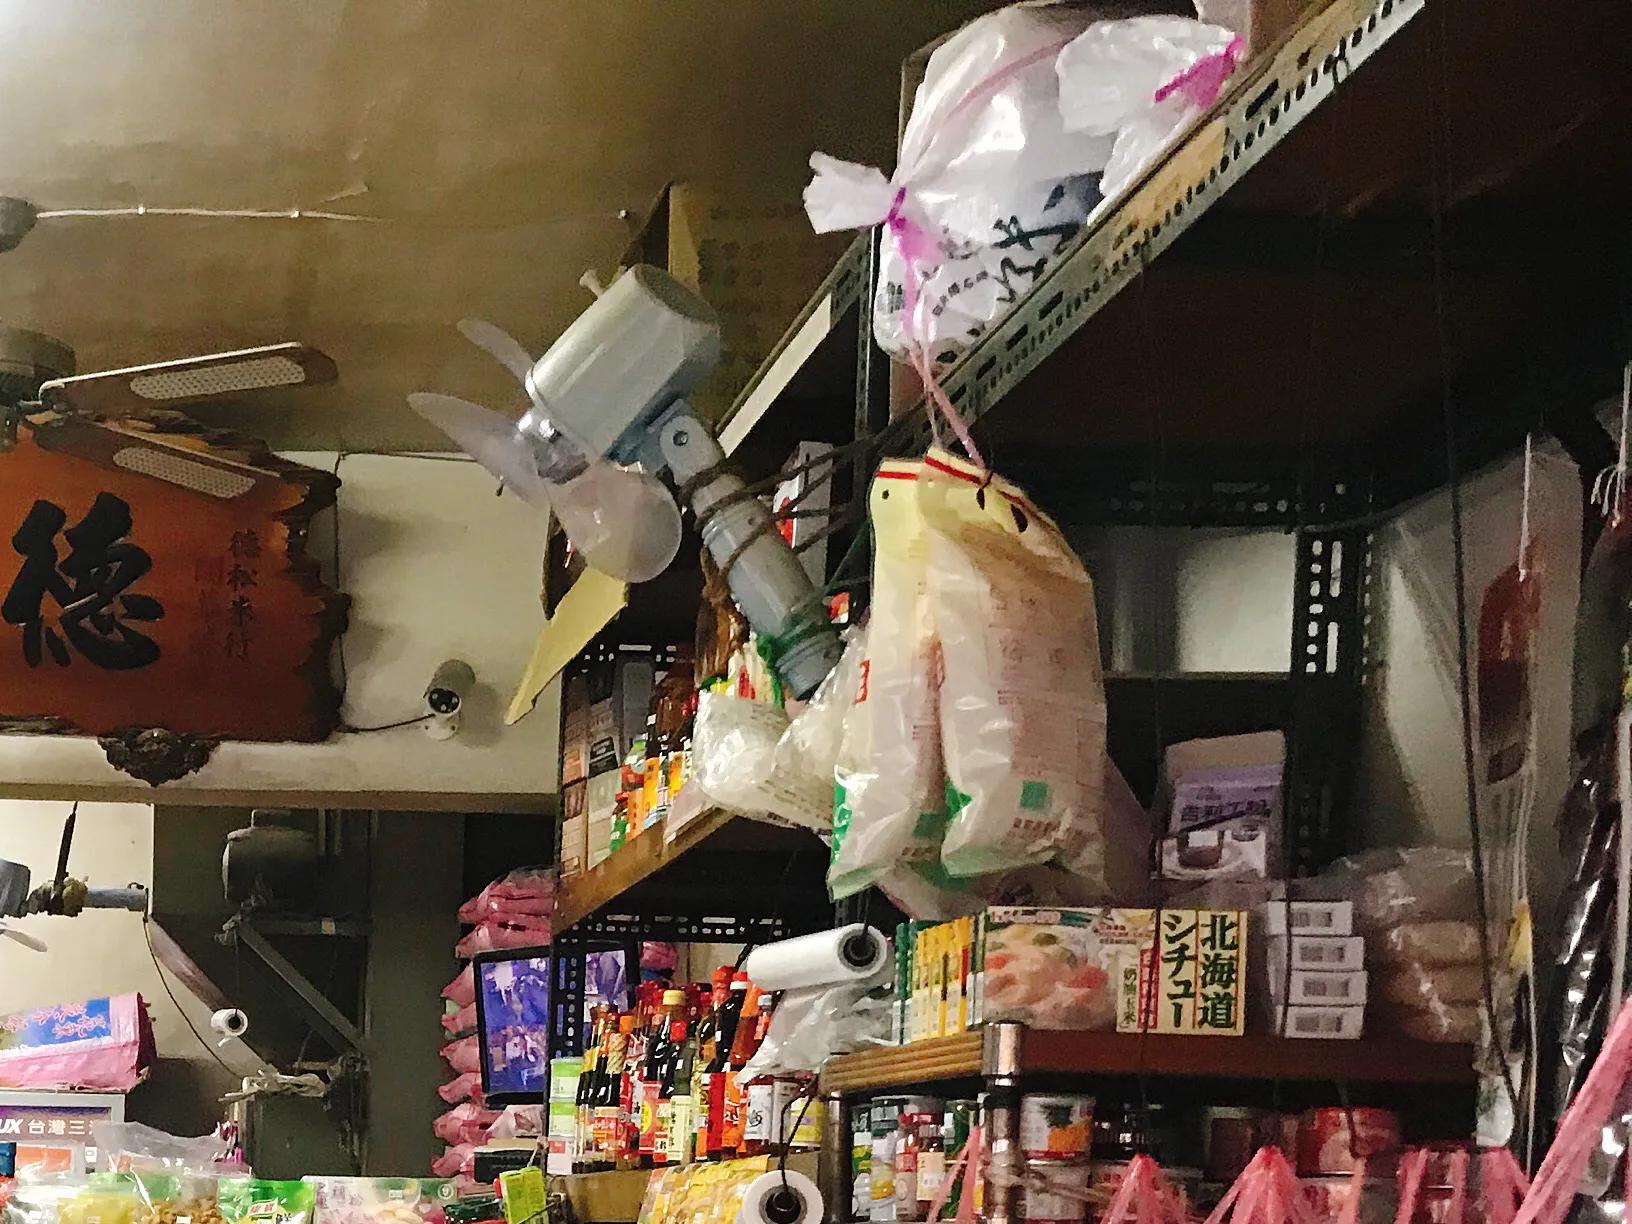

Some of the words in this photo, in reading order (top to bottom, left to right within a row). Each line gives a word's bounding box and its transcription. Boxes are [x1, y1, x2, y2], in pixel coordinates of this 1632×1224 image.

[1161, 913, 1196, 1029] シチュー
[1197, 914, 1237, 1030] 北海道
[28, 1119, 97, 1136] 台灣三
